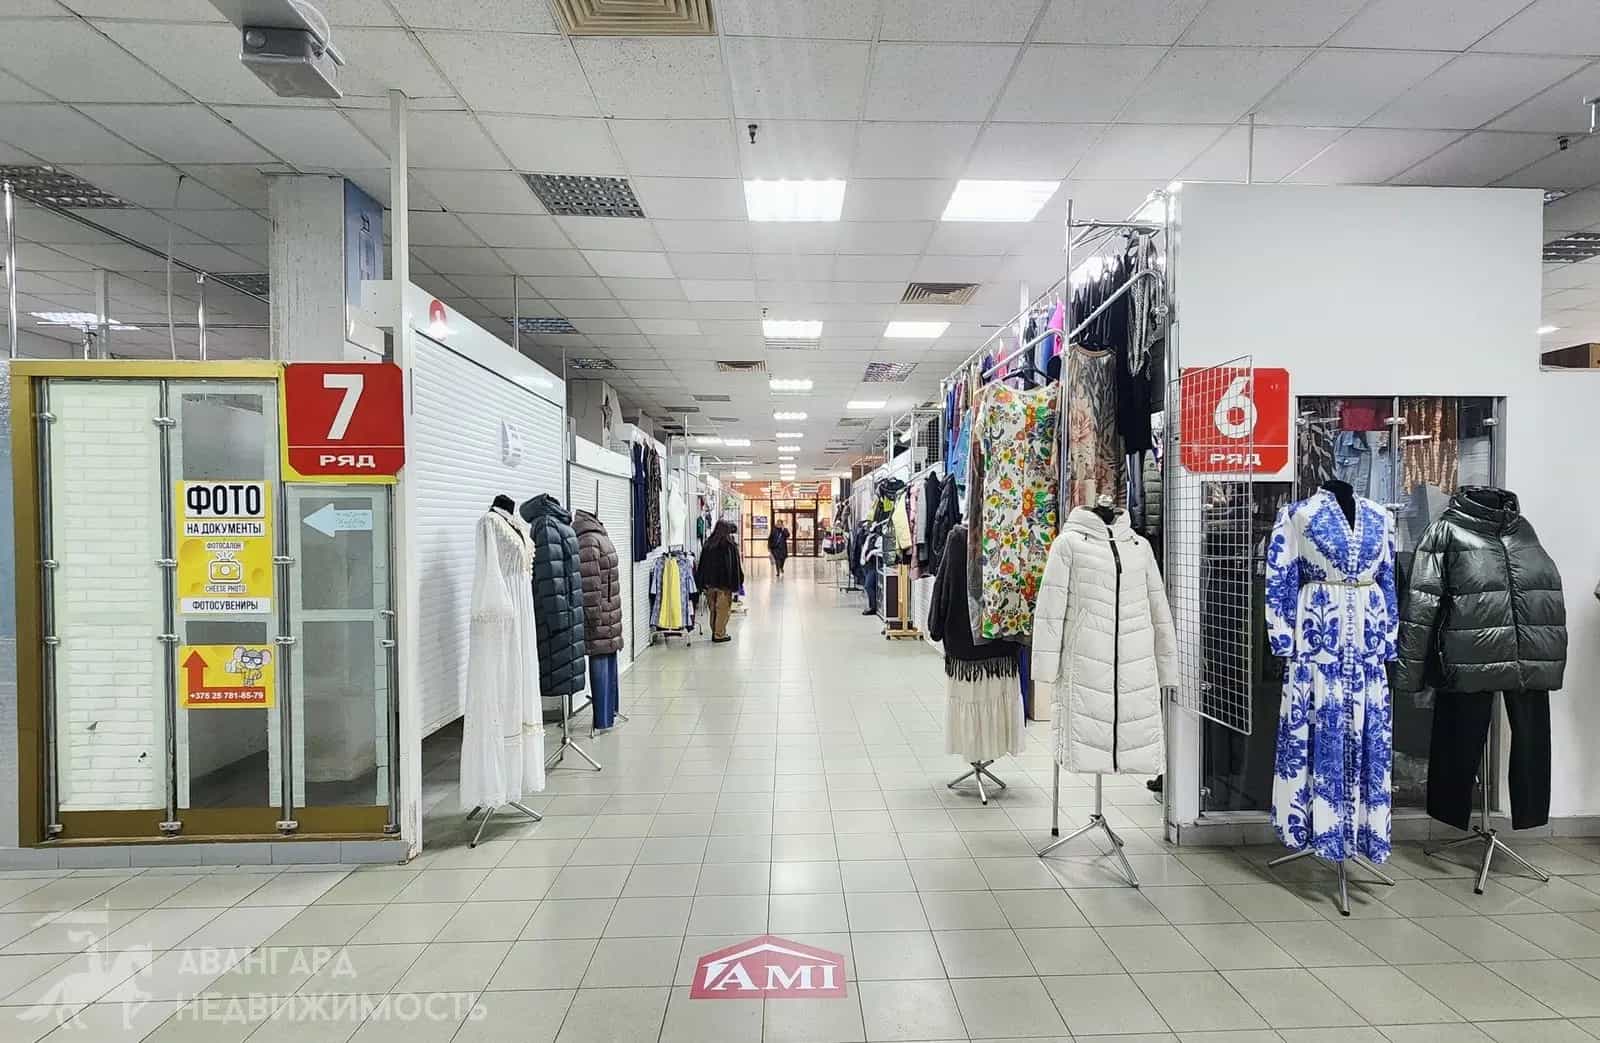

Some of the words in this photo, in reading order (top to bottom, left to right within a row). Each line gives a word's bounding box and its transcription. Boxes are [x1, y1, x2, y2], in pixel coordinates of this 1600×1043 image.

[323, 373, 364, 440] 7
[1214, 376, 1258, 439] 6
[319, 454, 376, 468] РЯД
[1210, 453, 1262, 466] РЯД
[187, 485, 261, 515] ФОТО
[187, 523, 200, 534] НА
[201, 523, 262, 535] ДОКУМЕНТЫ
[192, 600, 258, 611] ФОТОСУВЕНИРЫ
